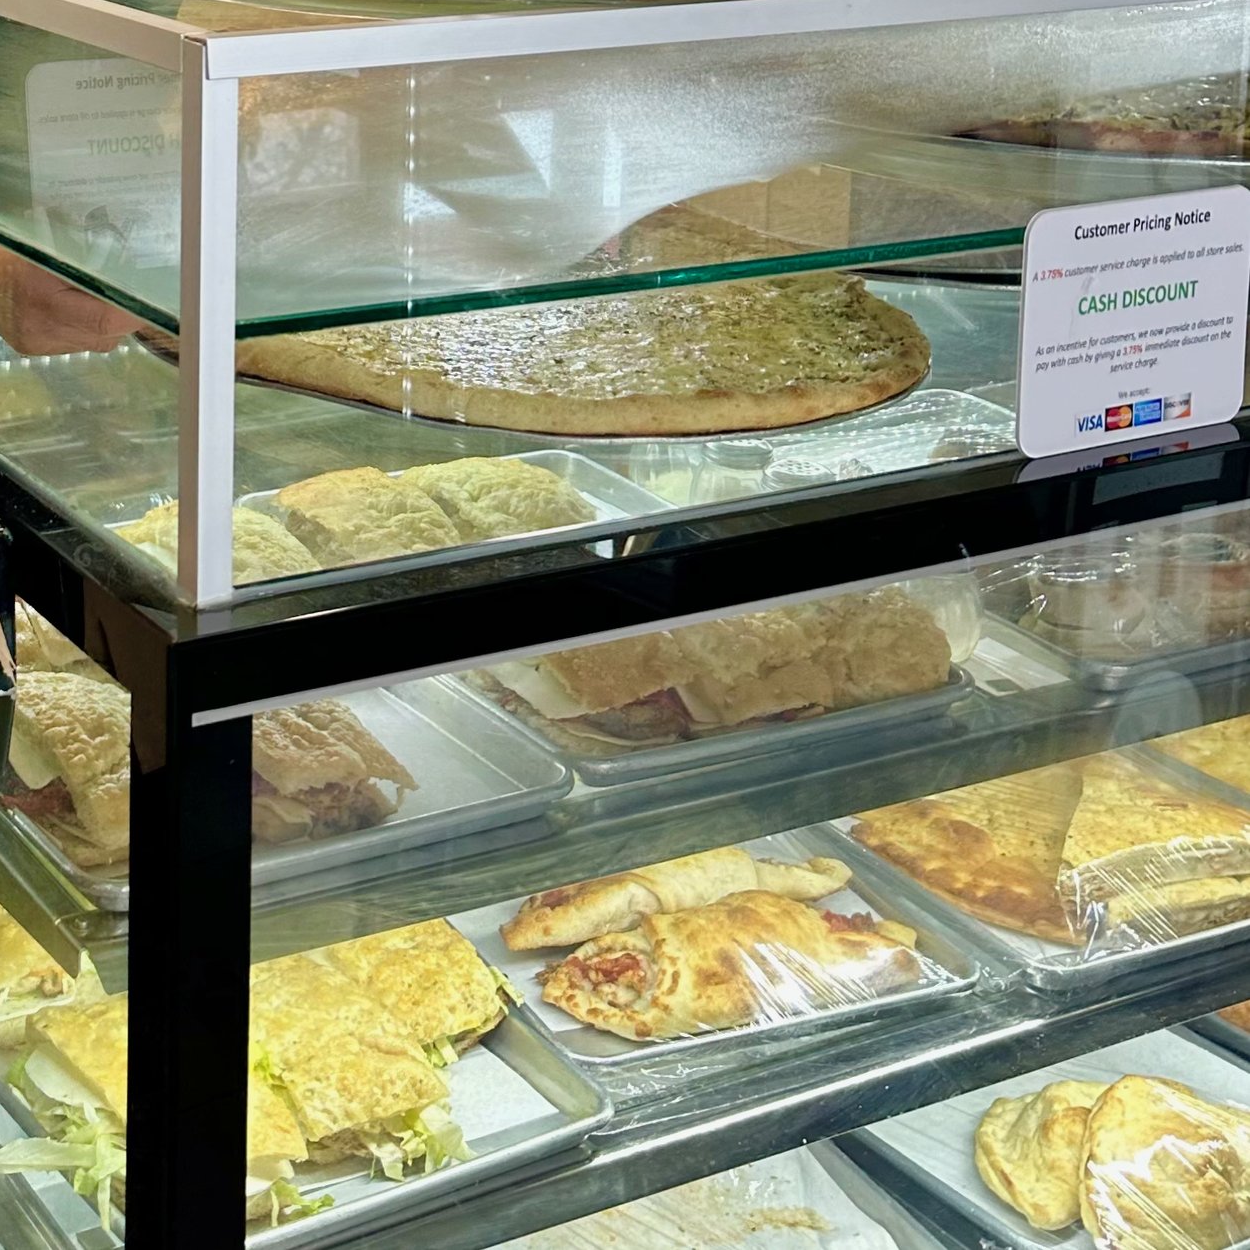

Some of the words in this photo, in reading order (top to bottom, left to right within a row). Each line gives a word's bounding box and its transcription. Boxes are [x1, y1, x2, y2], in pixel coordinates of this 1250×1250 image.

[1074, 222, 1130, 240] Customer
[1134, 215, 1172, 232] Pricing
[1174, 209, 1211, 227] Notice
[1032, 272, 1038, 282] A
[1040, 268, 1063, 281] 3.75%
[1064, 264, 1098, 277] customer
[1100, 260, 1125, 272] service
[1126, 256, 1151, 268] charge
[1152, 254, 1158, 264] is
[1160, 249, 1186, 265] applied
[1187, 249, 1195, 259] to
[1196, 247, 1205, 258] all
[1206, 245, 1224, 257] store
[1078, 292, 1117, 315] CASH
[1122, 280, 1198, 309] DISCOUNT
[1035, 345, 1044, 356] As
[1046, 345, 1055, 354] an
[1056, 339, 1087, 352] incentive
[1088, 336, 1099, 350] for
[1138, 330, 1148, 338] we
[1165, 323, 1190, 336] provide
[1197, 317, 1225, 329] discount
[1226, 316, 1234, 324] to
[1035, 361, 1049, 372] pay
[1050, 357, 1066, 368] with
[1067, 353, 1083, 366] cash
[1084, 352, 1093, 363] by
[1094, 349, 1115, 363] giving
[1144, 338, 1180, 352] immediate
[1181, 333, 1210, 346] discount
[1210, 333, 1219, 341] on
[1220, 330, 1232, 339] the
[1110, 362, 1133, 373] service
[1077, 414, 1103, 432] VISA
